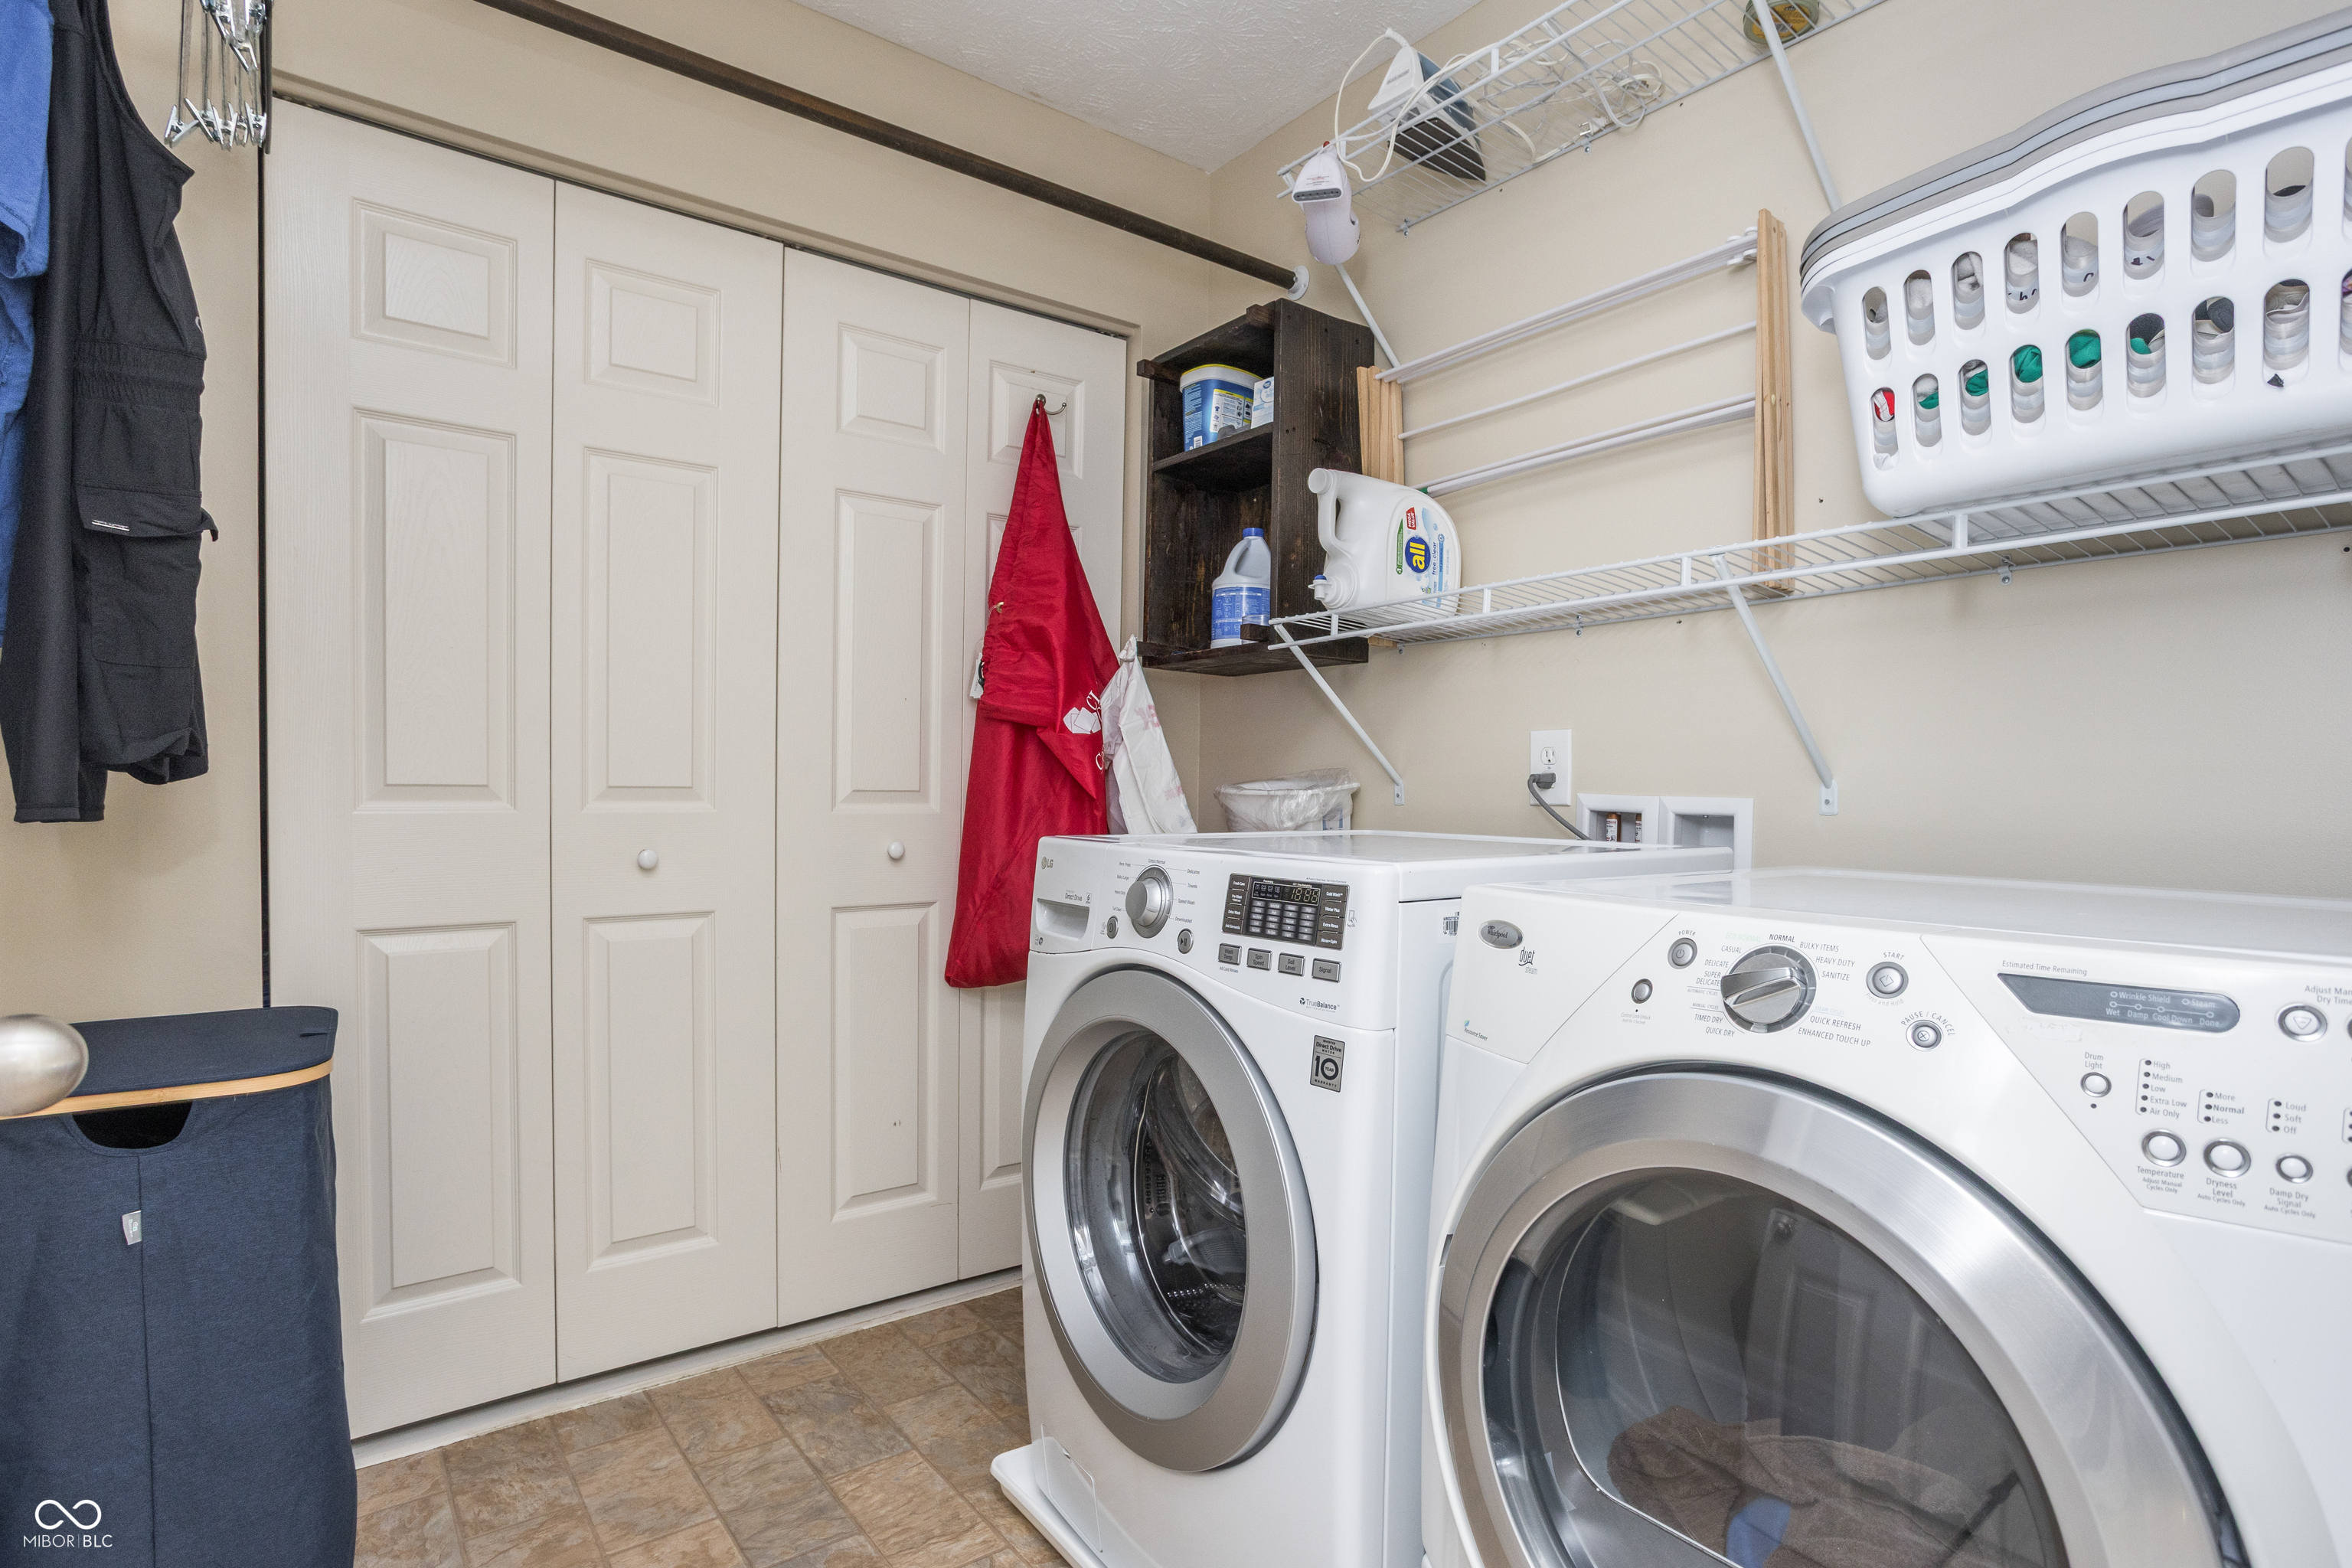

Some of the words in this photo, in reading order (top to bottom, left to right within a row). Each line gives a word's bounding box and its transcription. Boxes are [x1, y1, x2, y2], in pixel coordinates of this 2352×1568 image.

[1410, 542, 1425, 569] all
[1047, 859, 1054, 868] LG
[1487, 929, 1508, 938] Whirlpool
[1738, 934, 1761, 943] NORMAL
[1769, 934, 1795, 943] NORMAL
[1721, 945, 1742, 954] CASUAL
[1800, 942, 1819, 950] BULKY
[1820, 944, 1839, 952] ITEMS
[1519, 946, 1535, 965] duet
[1883, 952, 1905, 960] START
[1704, 959, 1729, 968] DELICATE
[1815, 956, 1836, 965] HEAVY
[1838, 959, 1855, 968] DUTY
[1525, 966, 1538, 975] steam
[2002, 960, 2034, 970] Estimated
[2052, 965, 2087, 977] Remaining
[1822, 971, 1850, 981] SANITIZE
[1696, 978, 1720, 987] DELICATE
[2305, 985, 2331, 994] Adjust
[1865, 992, 1877, 1003] Press
[2119, 991, 2146, 1001] Wrinkle
[2148, 994, 2171, 1003] Shield
[2317, 995, 2331, 1005] Dry
[2191, 999, 2215, 1008] Steam
[1694, 1014, 1711, 1022] TIMED
[2106, 1008, 2120, 1016] Wet
[2127, 1010, 2149, 1020] Damp
[2152, 1013, 2169, 1021] Cool
[2171, 1015, 2193, 1024] Down
[2199, 1018, 2219, 1027] Done
[1810, 1015, 1830, 1026] QUICK
[1832, 1019, 1861, 1031] REFRESH
[1901, 1011, 1924, 1026] PAUSE
[1931, 1013, 1956, 1036] CANCEL
[1464, 1027, 1478, 1038] Resource
[1478, 1033, 1488, 1041] Saver
[1705, 1026, 1722, 1035] QUICK
[1723, 1029, 1735, 1037] DRY
[1798, 1027, 1834, 1040] ENHANCED
[1836, 1034, 1859, 1045] TOUCH
[1860, 1038, 1871, 1047] UP
[2085, 1052, 2104, 1061] Drum
[1315, 1055, 1339, 1080] 10
[2085, 1061, 2102, 1070] Light
[2153, 1061, 2171, 1070] High
[1314, 1079, 1337, 1087] WARRANTY
[2152, 1073, 2182, 1083] Medium
[2150, 1096, 2169, 1105] Extra
[2215, 1092, 2235, 1101] More
[2213, 1104, 2244, 1114] Normal
[2286, 1102, 2306, 1112] Loud
[2163, 1110, 2180, 1119] Only
[2284, 1114, 2302, 1123] Soft
[2212, 1116, 2228, 1124] Less
[2283, 1126, 2297, 1134] Off
[2137, 1166, 2184, 1179] Temperature
[2206, 1177, 2237, 1189] Dryness
[2212, 1188, 2233, 1198] Level
[2269, 1187, 2292, 1199] Damp
[2295, 1191, 2309, 1201] Dry
[2232, 1199, 2245, 1207] Only
[2277, 1197, 2301, 1208] Signal
[2280, 1207, 2299, 1215] Cycles
[2301, 1210, 2315, 1219] Only
